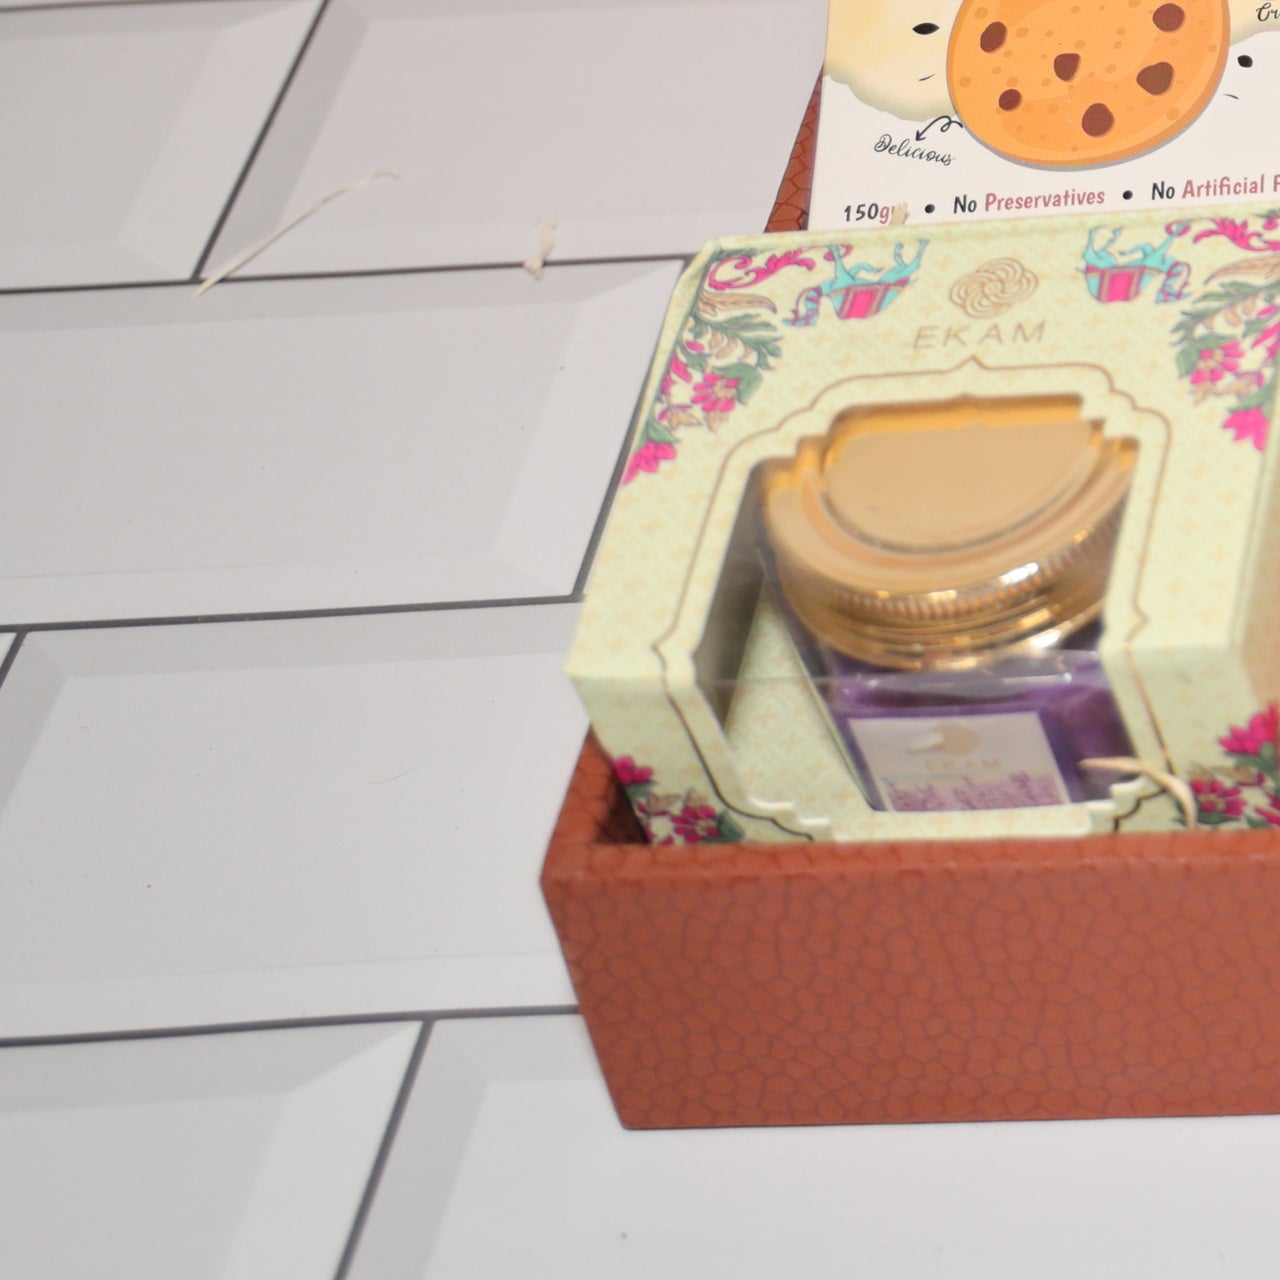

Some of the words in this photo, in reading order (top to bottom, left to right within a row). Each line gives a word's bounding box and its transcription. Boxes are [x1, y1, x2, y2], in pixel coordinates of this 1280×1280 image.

[874, 133, 956, 166] Delicious
[843, 202, 903, 225] 150g
[953, 194, 977, 215] No
[985, 189, 1106, 212] Preservatives
[1151, 181, 1175, 201] No
[1182, 174, 1265, 200] Artificial
[913, 320, 1046, 350] EKAM
